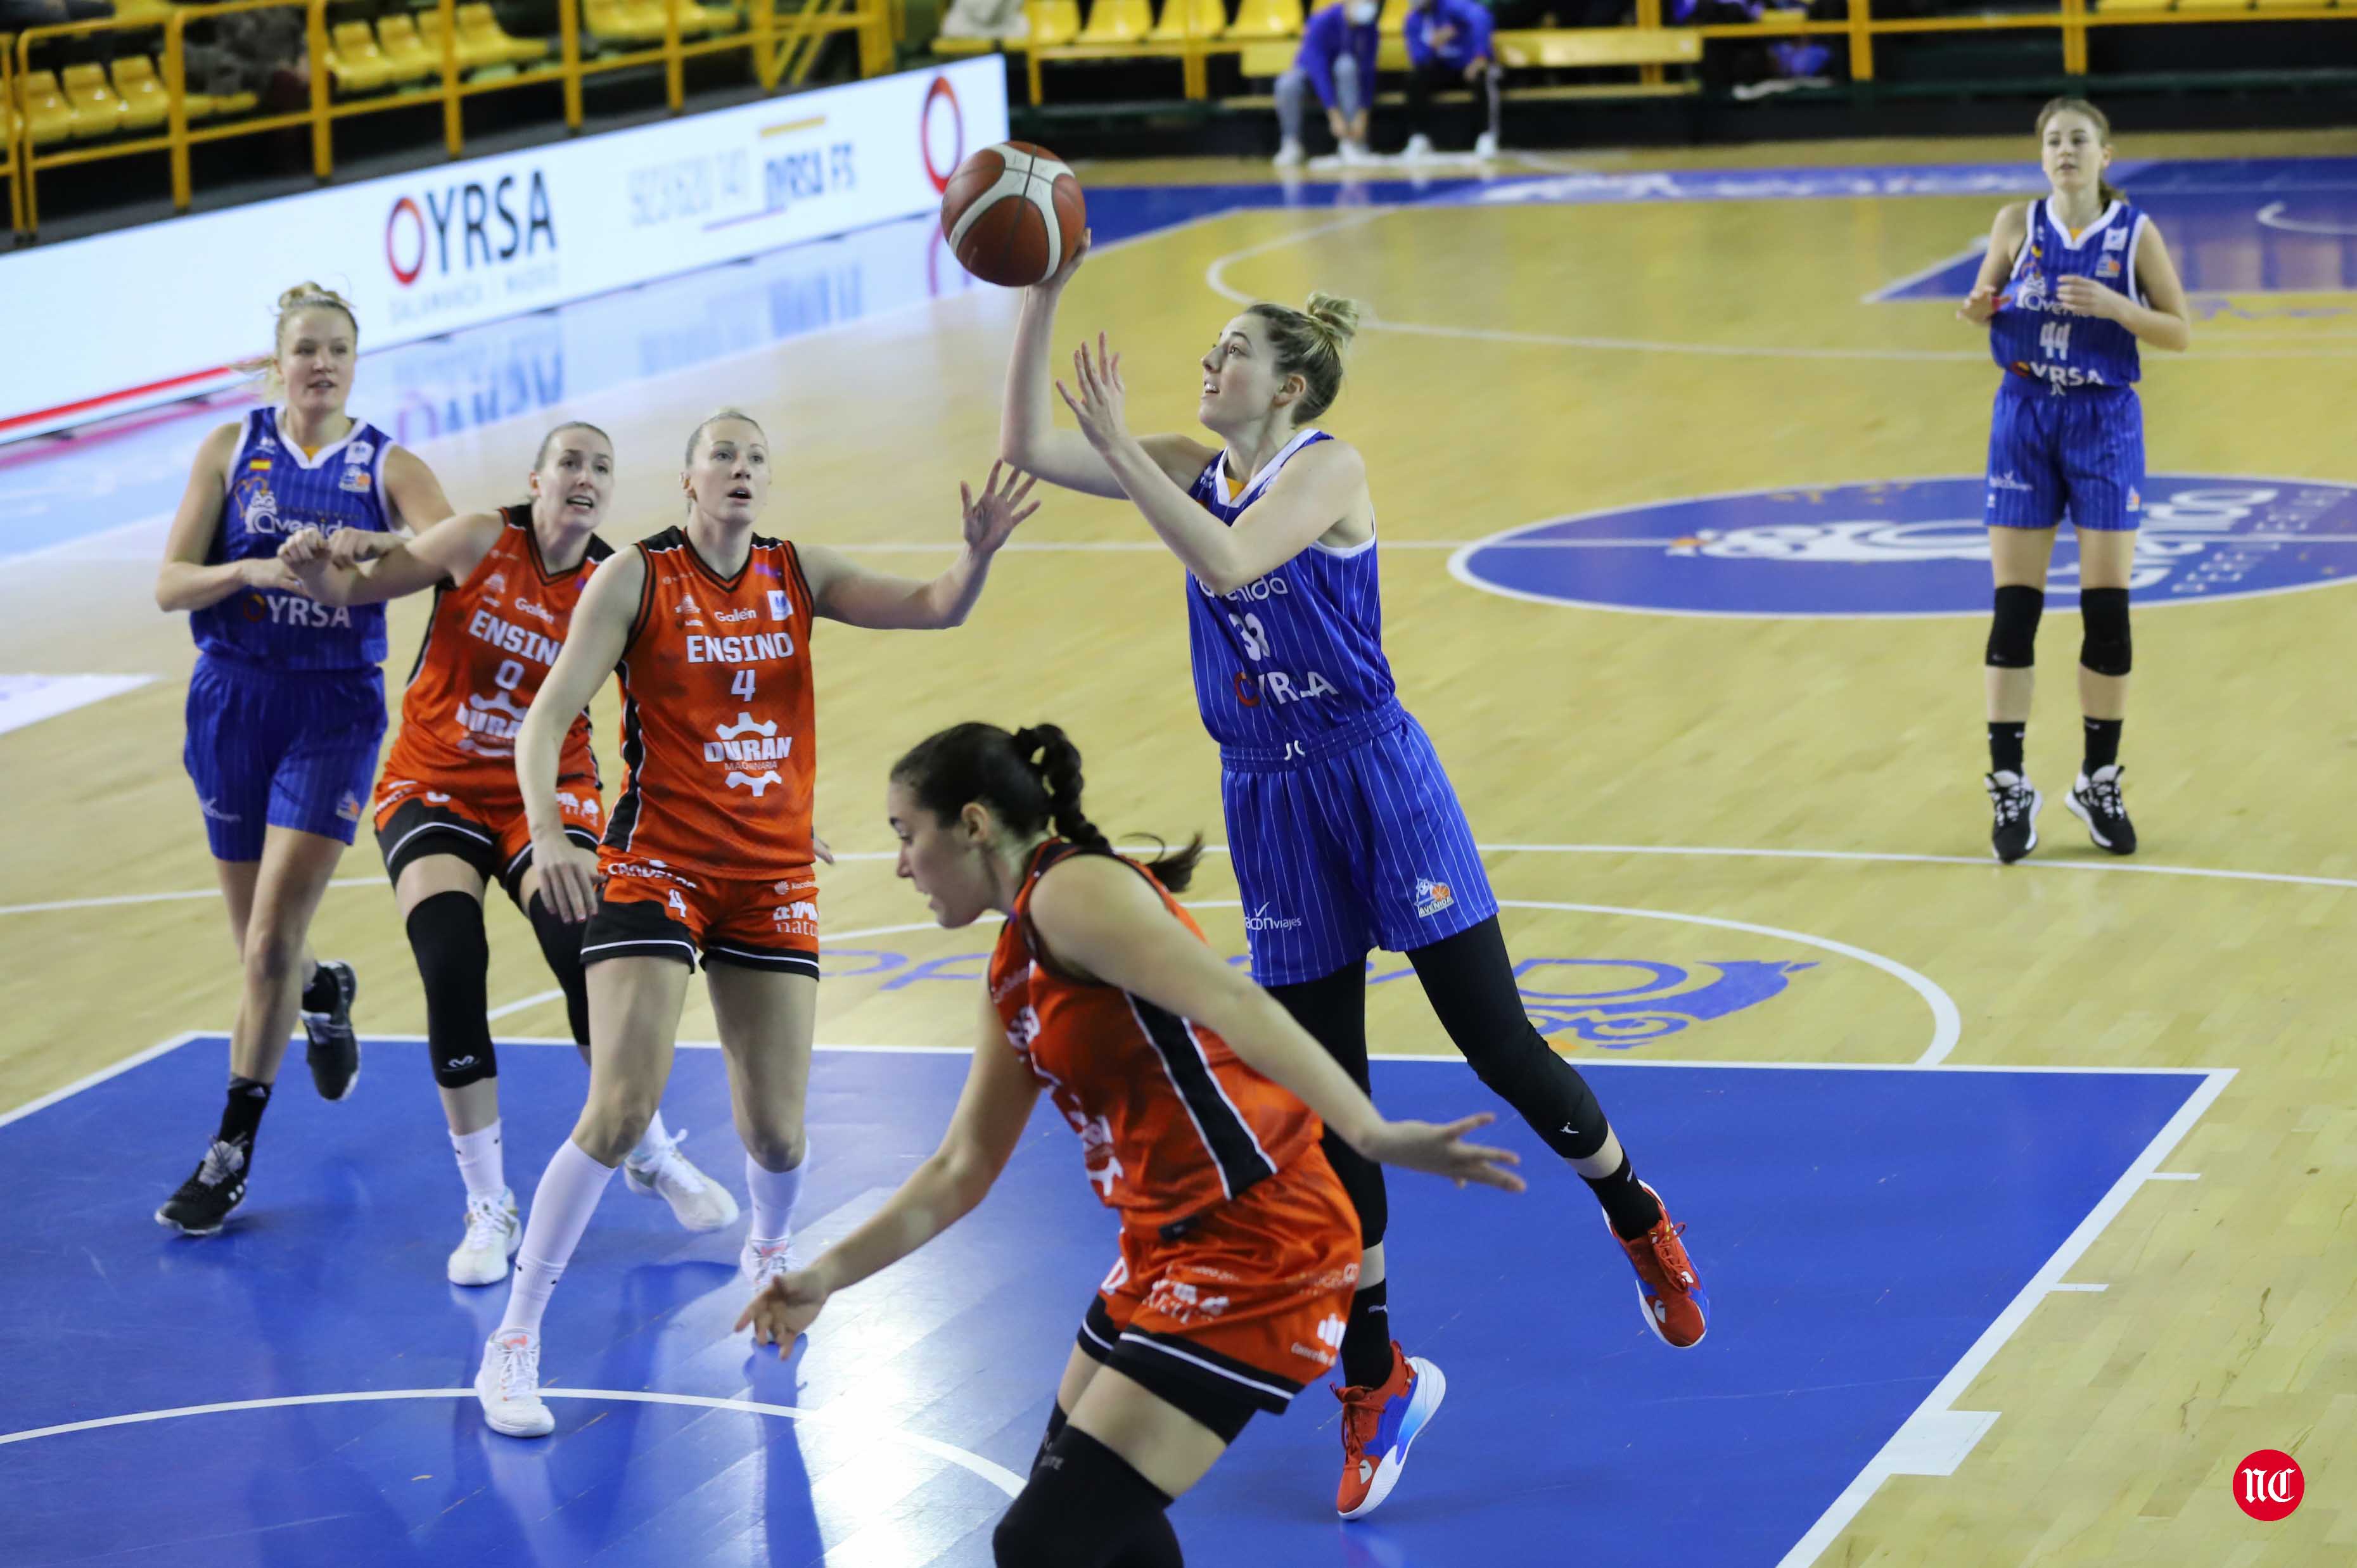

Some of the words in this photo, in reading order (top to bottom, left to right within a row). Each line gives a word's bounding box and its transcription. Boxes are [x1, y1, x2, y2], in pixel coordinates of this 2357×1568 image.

[2040, 321, 2071, 360] 44
[243, 593, 352, 629] OYRSA
[714, 608, 757, 623] Galén
[469, 609, 566, 666] ENSIN
[686, 632, 795, 663] ENSINO
[731, 669, 756, 702] 4
[704, 736, 792, 763] DURAN
[668, 889, 687, 918] 4
[1274, 917, 1302, 931] viajes
